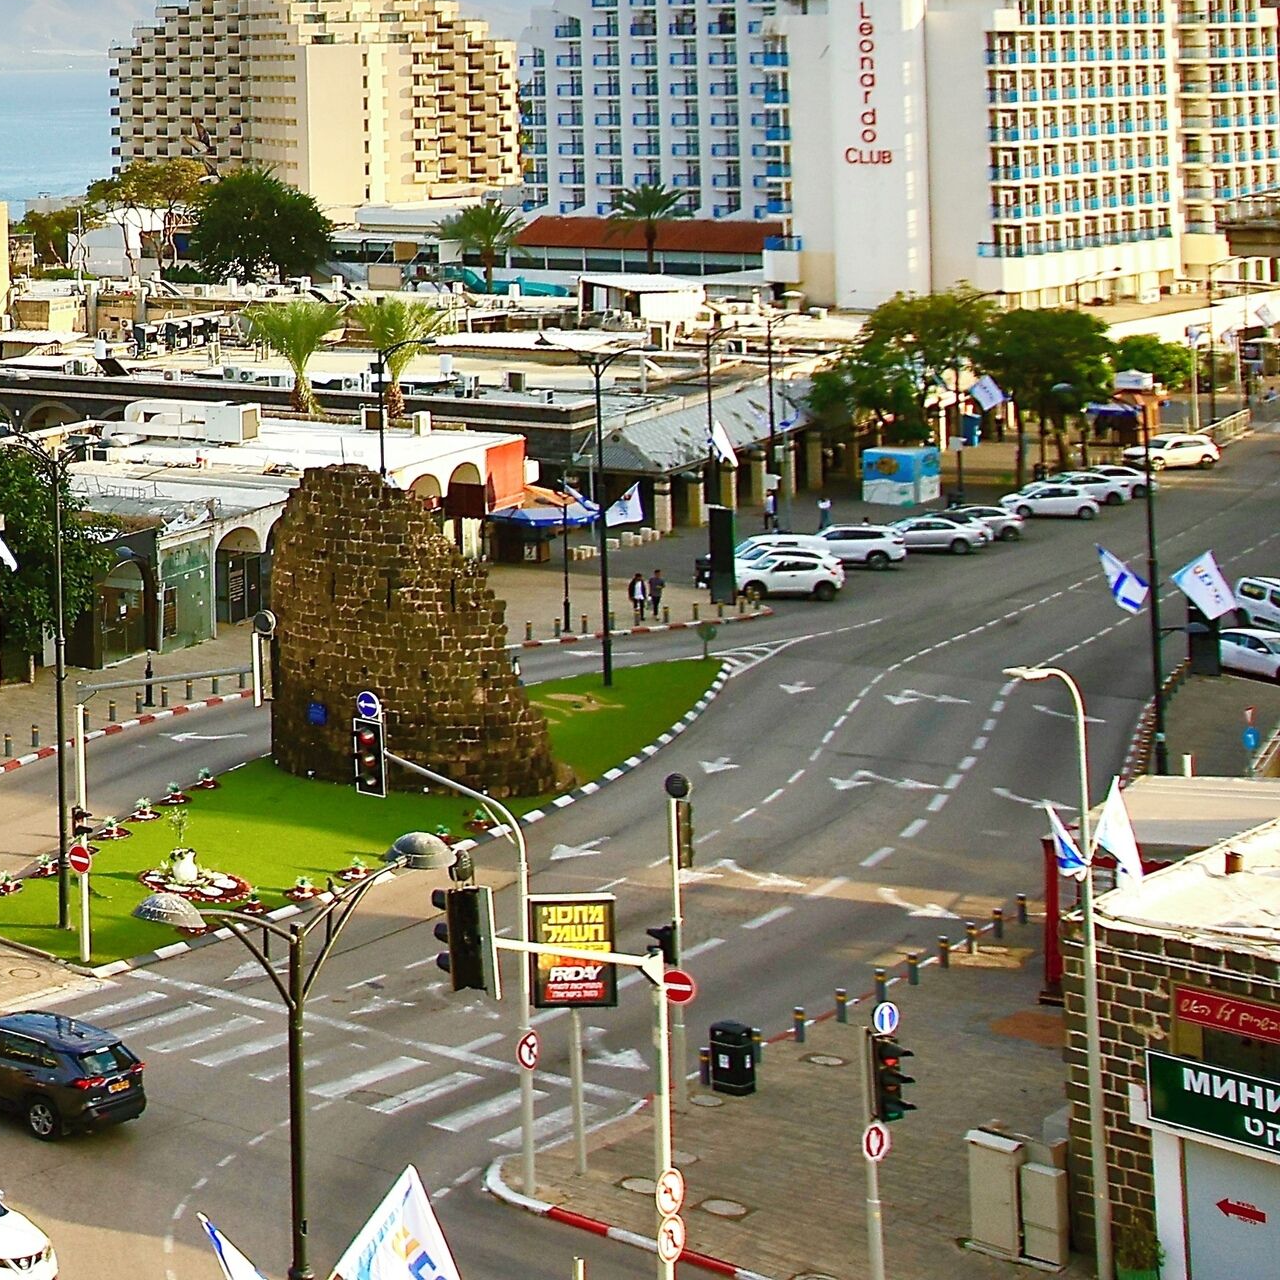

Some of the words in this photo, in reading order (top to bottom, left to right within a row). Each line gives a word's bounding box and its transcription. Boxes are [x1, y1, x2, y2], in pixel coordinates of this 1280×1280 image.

[858, 0, 877, 143] Leonardo
[845, 147, 893, 165] CLUB
[542, 905, 604, 924] מחסני
[541, 922, 605, 942] חשמל
[549, 965, 603, 982] FRIDAY
